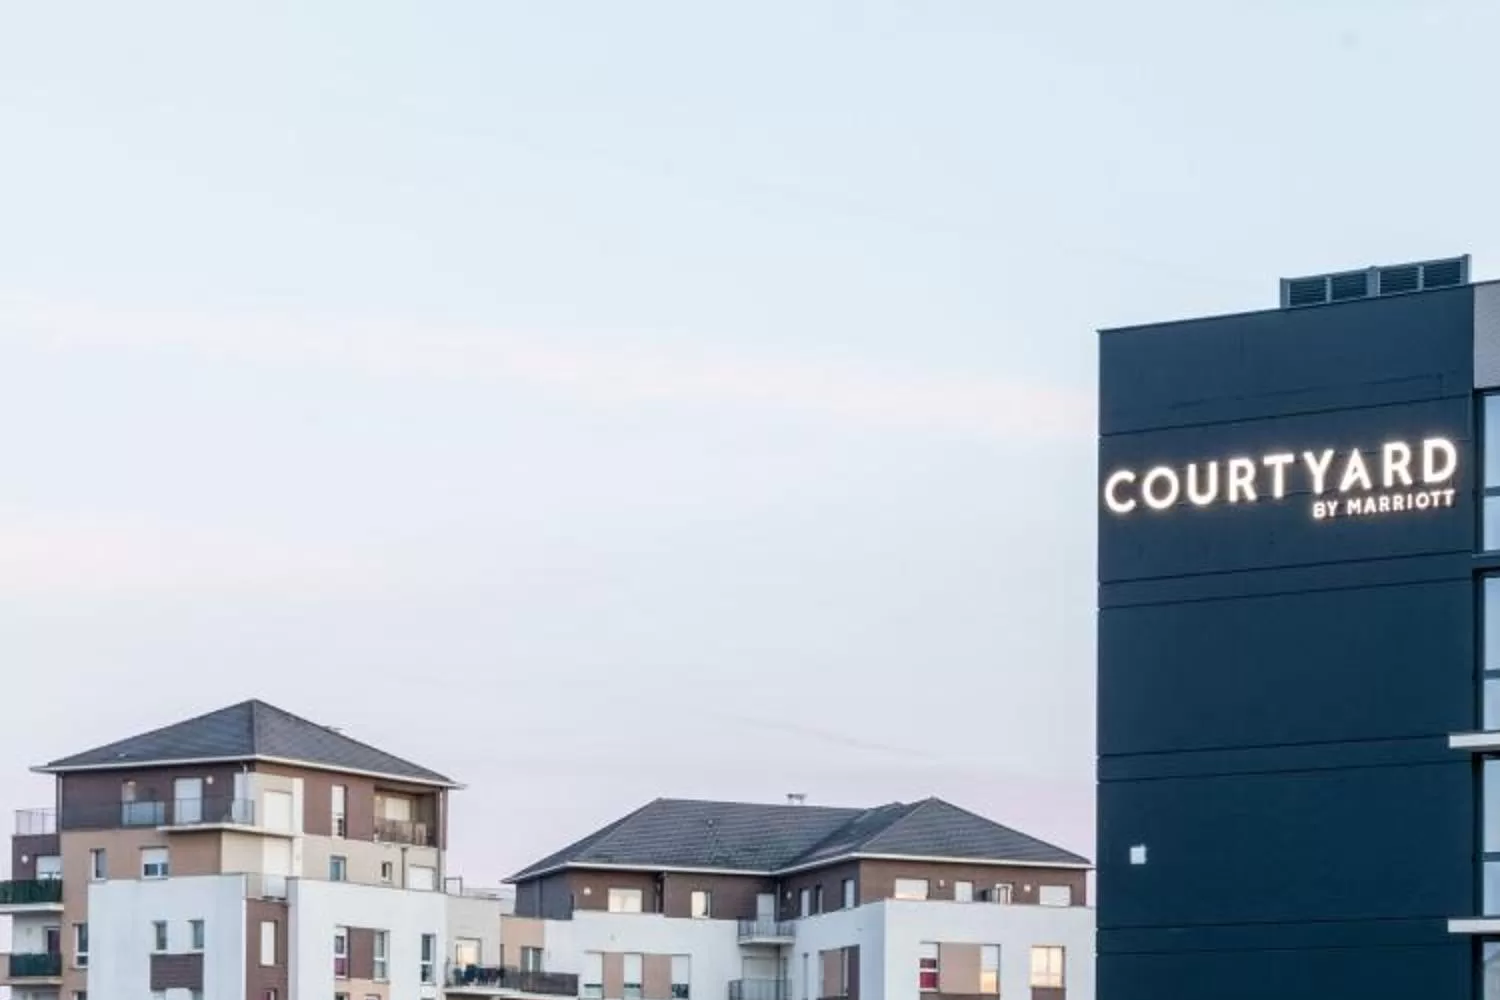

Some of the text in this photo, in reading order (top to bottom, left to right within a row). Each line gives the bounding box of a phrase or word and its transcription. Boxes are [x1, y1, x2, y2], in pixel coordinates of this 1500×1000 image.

[1105, 437, 1457, 513] COURTYARD
[1313, 489, 1455, 519] BY MARRIOTT
